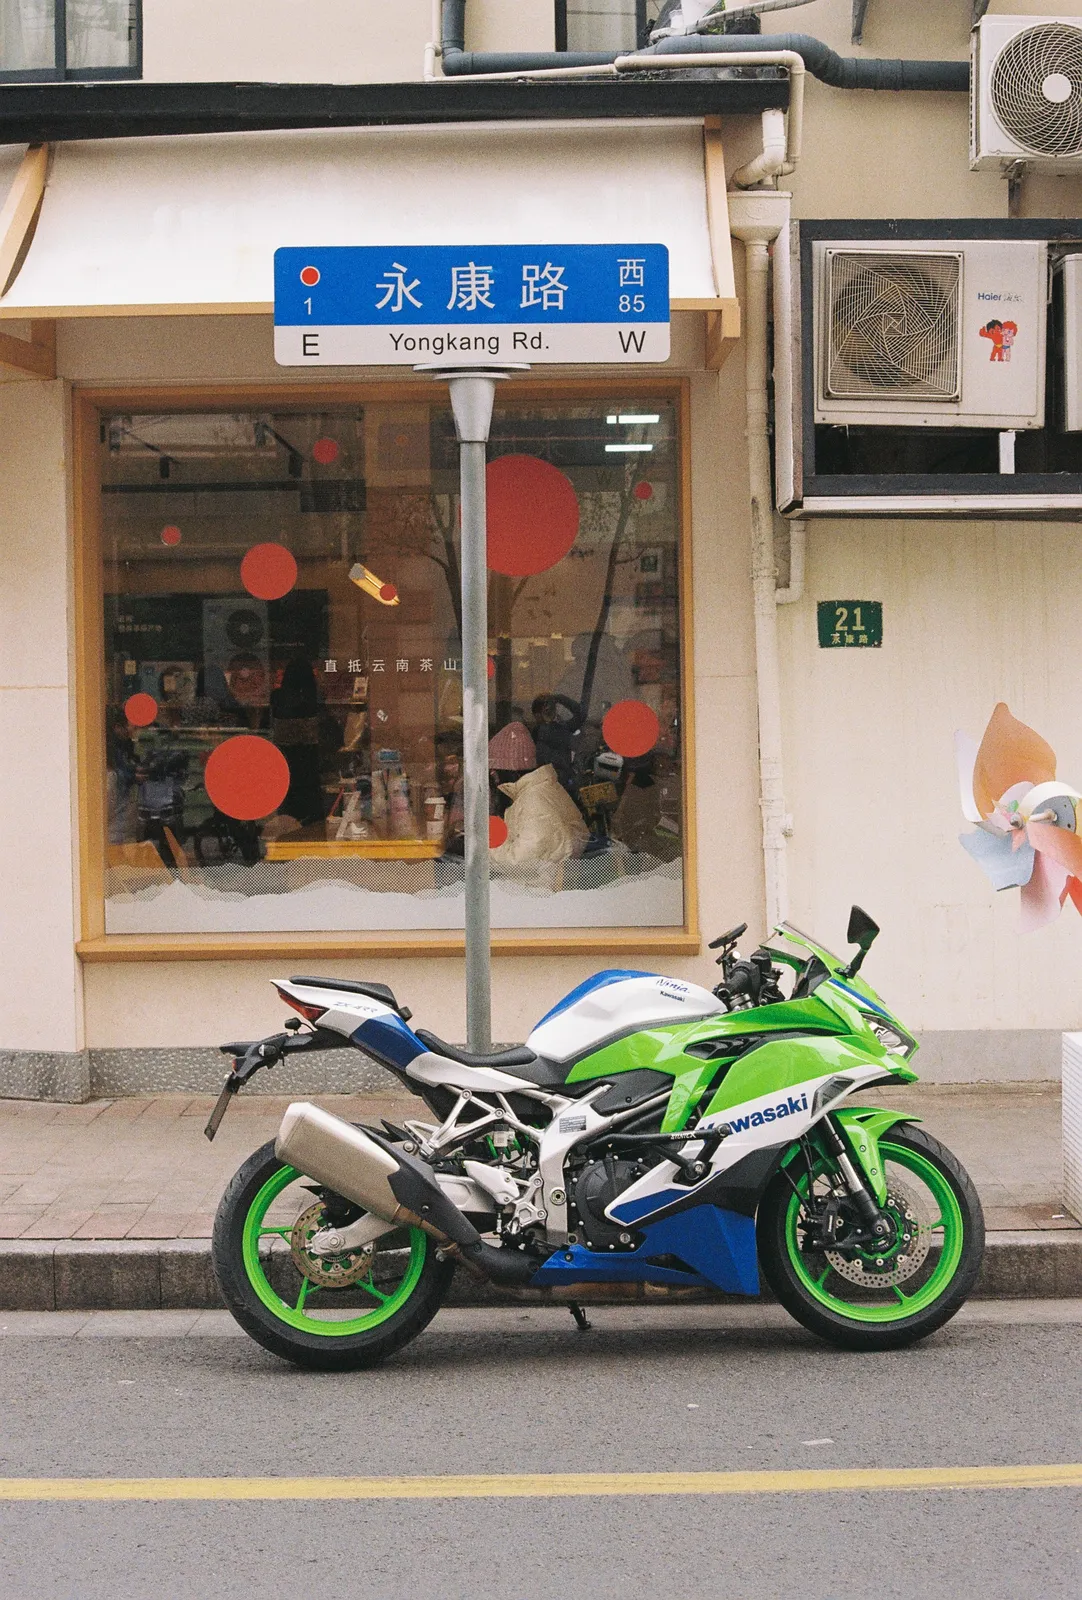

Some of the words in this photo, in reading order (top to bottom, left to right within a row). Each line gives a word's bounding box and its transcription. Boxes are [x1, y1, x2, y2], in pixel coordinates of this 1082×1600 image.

[616, 258, 646, 288] 西
[374, 261, 569, 313] 永康路
[977, 292, 1002, 301] Haier
[303, 297, 312, 315] 1
[618, 294, 646, 313] 85
[302, 333, 320, 356] E
[389, 332, 500, 355] Yongkang
[512, 331, 550, 350] Rd.
[618, 330, 647, 353] W
[835, 607, 866, 631] 21
[323, 657, 458, 673] 直抵云南茶山
[660, 990, 686, 1003] Kawasaki
